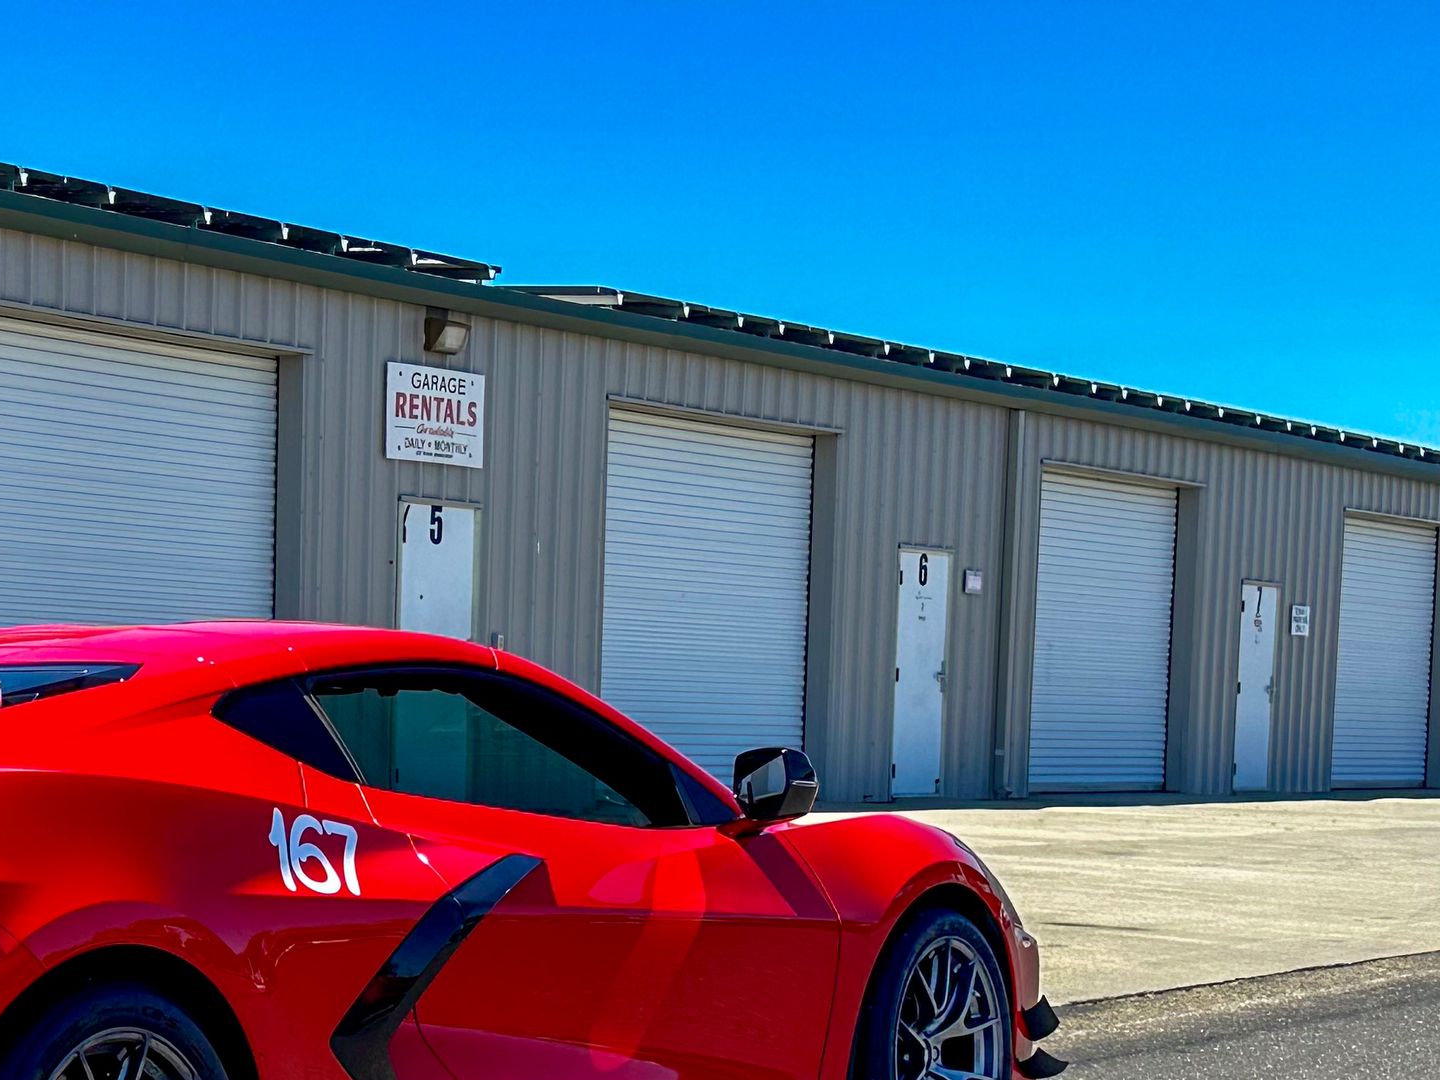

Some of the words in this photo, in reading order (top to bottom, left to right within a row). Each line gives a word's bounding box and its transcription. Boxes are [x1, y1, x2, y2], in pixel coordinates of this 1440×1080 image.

[411, 372, 466, 395] GARAGE
[395, 392, 477, 427] RENTALS
[404, 437, 426, 449] DAILY
[434, 440, 468, 454] MONTHLY
[429, 505, 443, 545] 5
[919, 553, 928, 586] 6
[269, 807, 360, 896] 167
